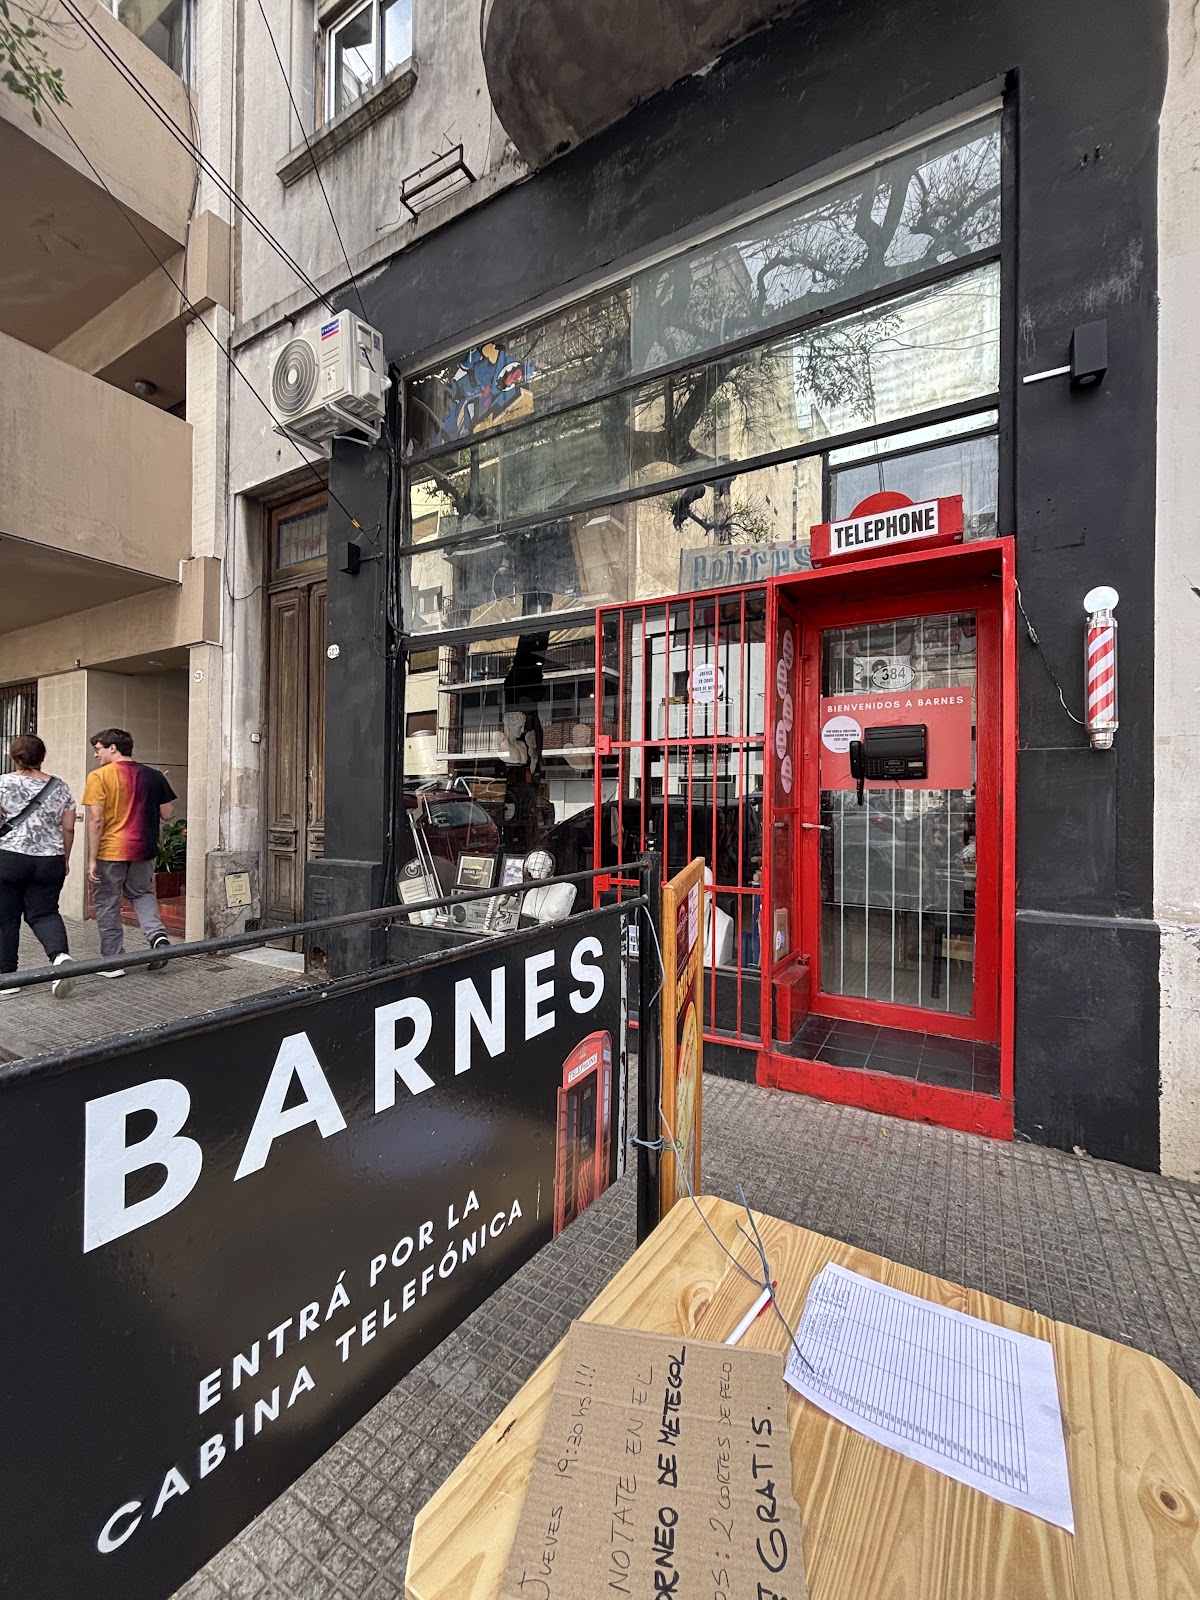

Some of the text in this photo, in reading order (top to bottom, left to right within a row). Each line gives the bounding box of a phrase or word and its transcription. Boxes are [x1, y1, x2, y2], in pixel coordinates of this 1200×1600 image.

[834, 507, 936, 549] TELEPHONE
[881, 667, 906, 680] 384
[827, 696, 964, 713] BIENVENIDOS A BARNES
[83, 936, 605, 1254] BARNES
[198, 1190, 480, 1415] ENTRÁ POR LA
[97, 1198, 523, 1554] CABINA TELEFÓNICA
[657, 1345, 686, 1446] METEGOL
[719, 1362, 732, 1400] PELO
[718, 1405, 732, 1426] DE
[608, 1365, 653, 1594] NOTATE EN EL
[657, 1453, 678, 1488] DE
[717, 1437, 731, 1510] CORTES
[709, 1517, 733, 1542] 2
